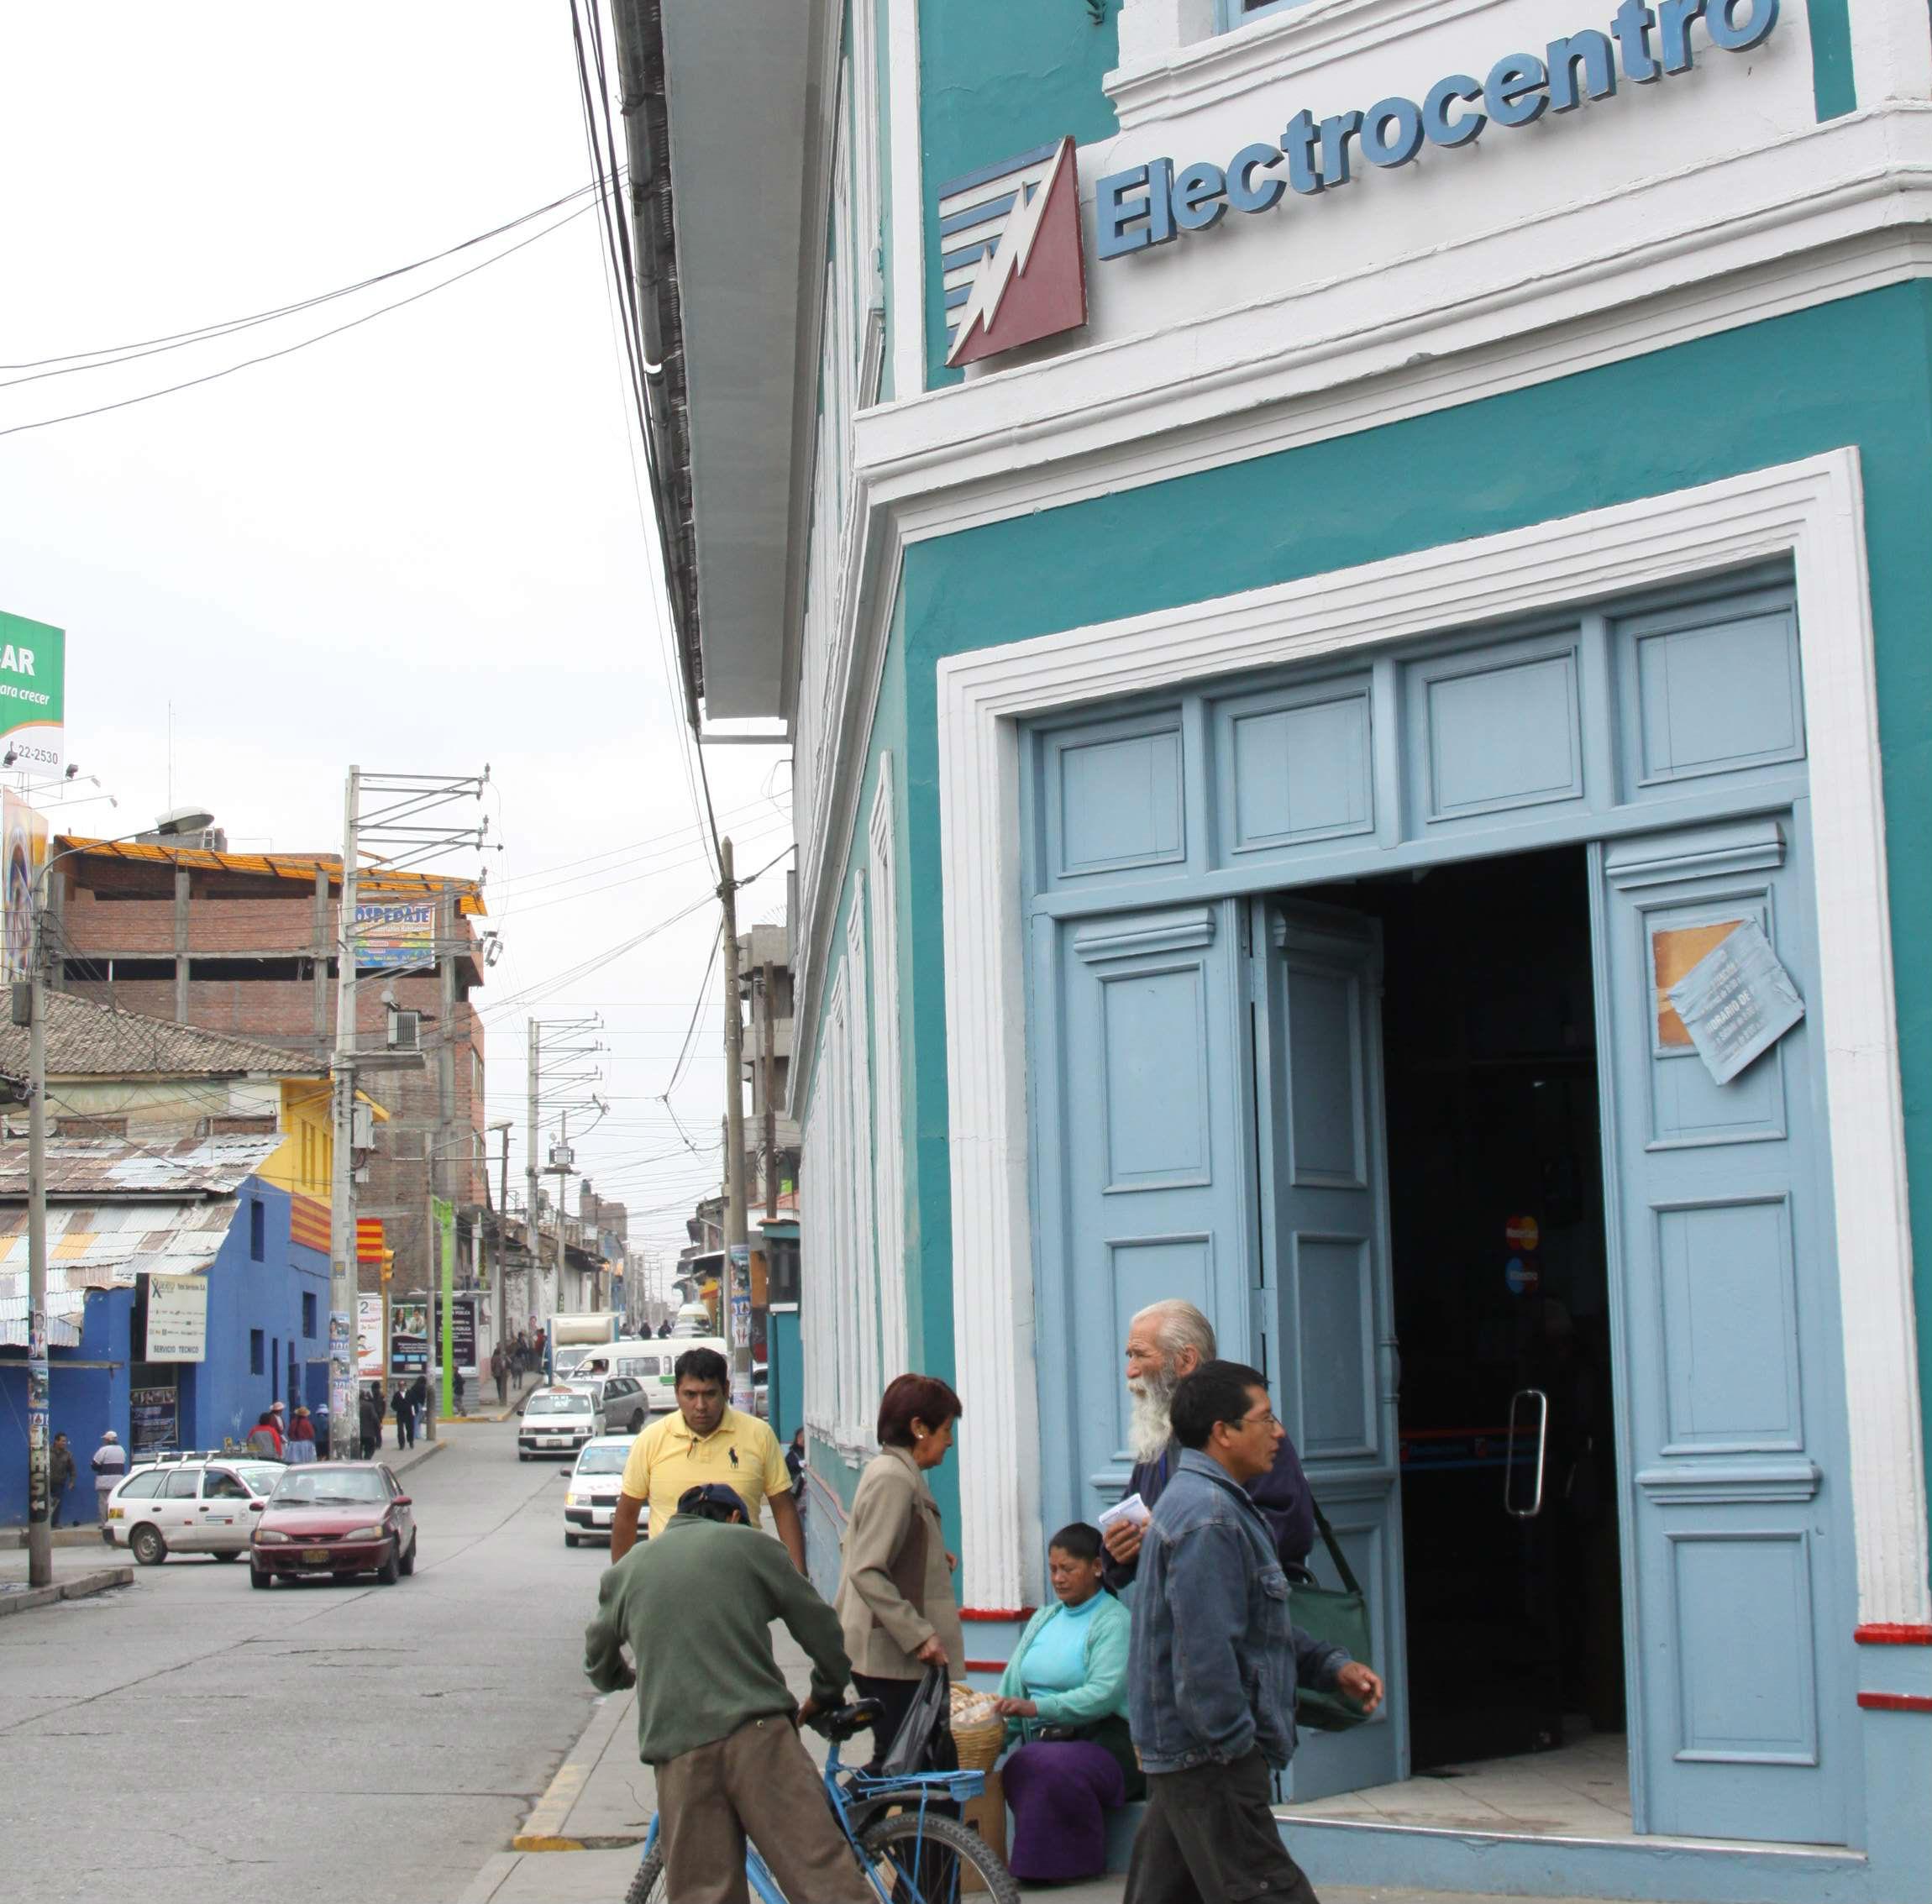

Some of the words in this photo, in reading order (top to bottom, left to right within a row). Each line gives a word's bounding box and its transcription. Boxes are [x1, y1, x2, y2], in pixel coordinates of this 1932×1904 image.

[1095, 0, 1780, 261] Electrocentro
[0, 644, 34, 676] AR
[0, 684, 18, 698] ara
[19, 689, 50, 705] crecer
[18, 744, 58, 765] 22-2530
[355, 905, 430, 923] OSPEDAJE
[360, 1301, 369, 1314] 2
[153, 1345, 176, 1354] SERVICIO
